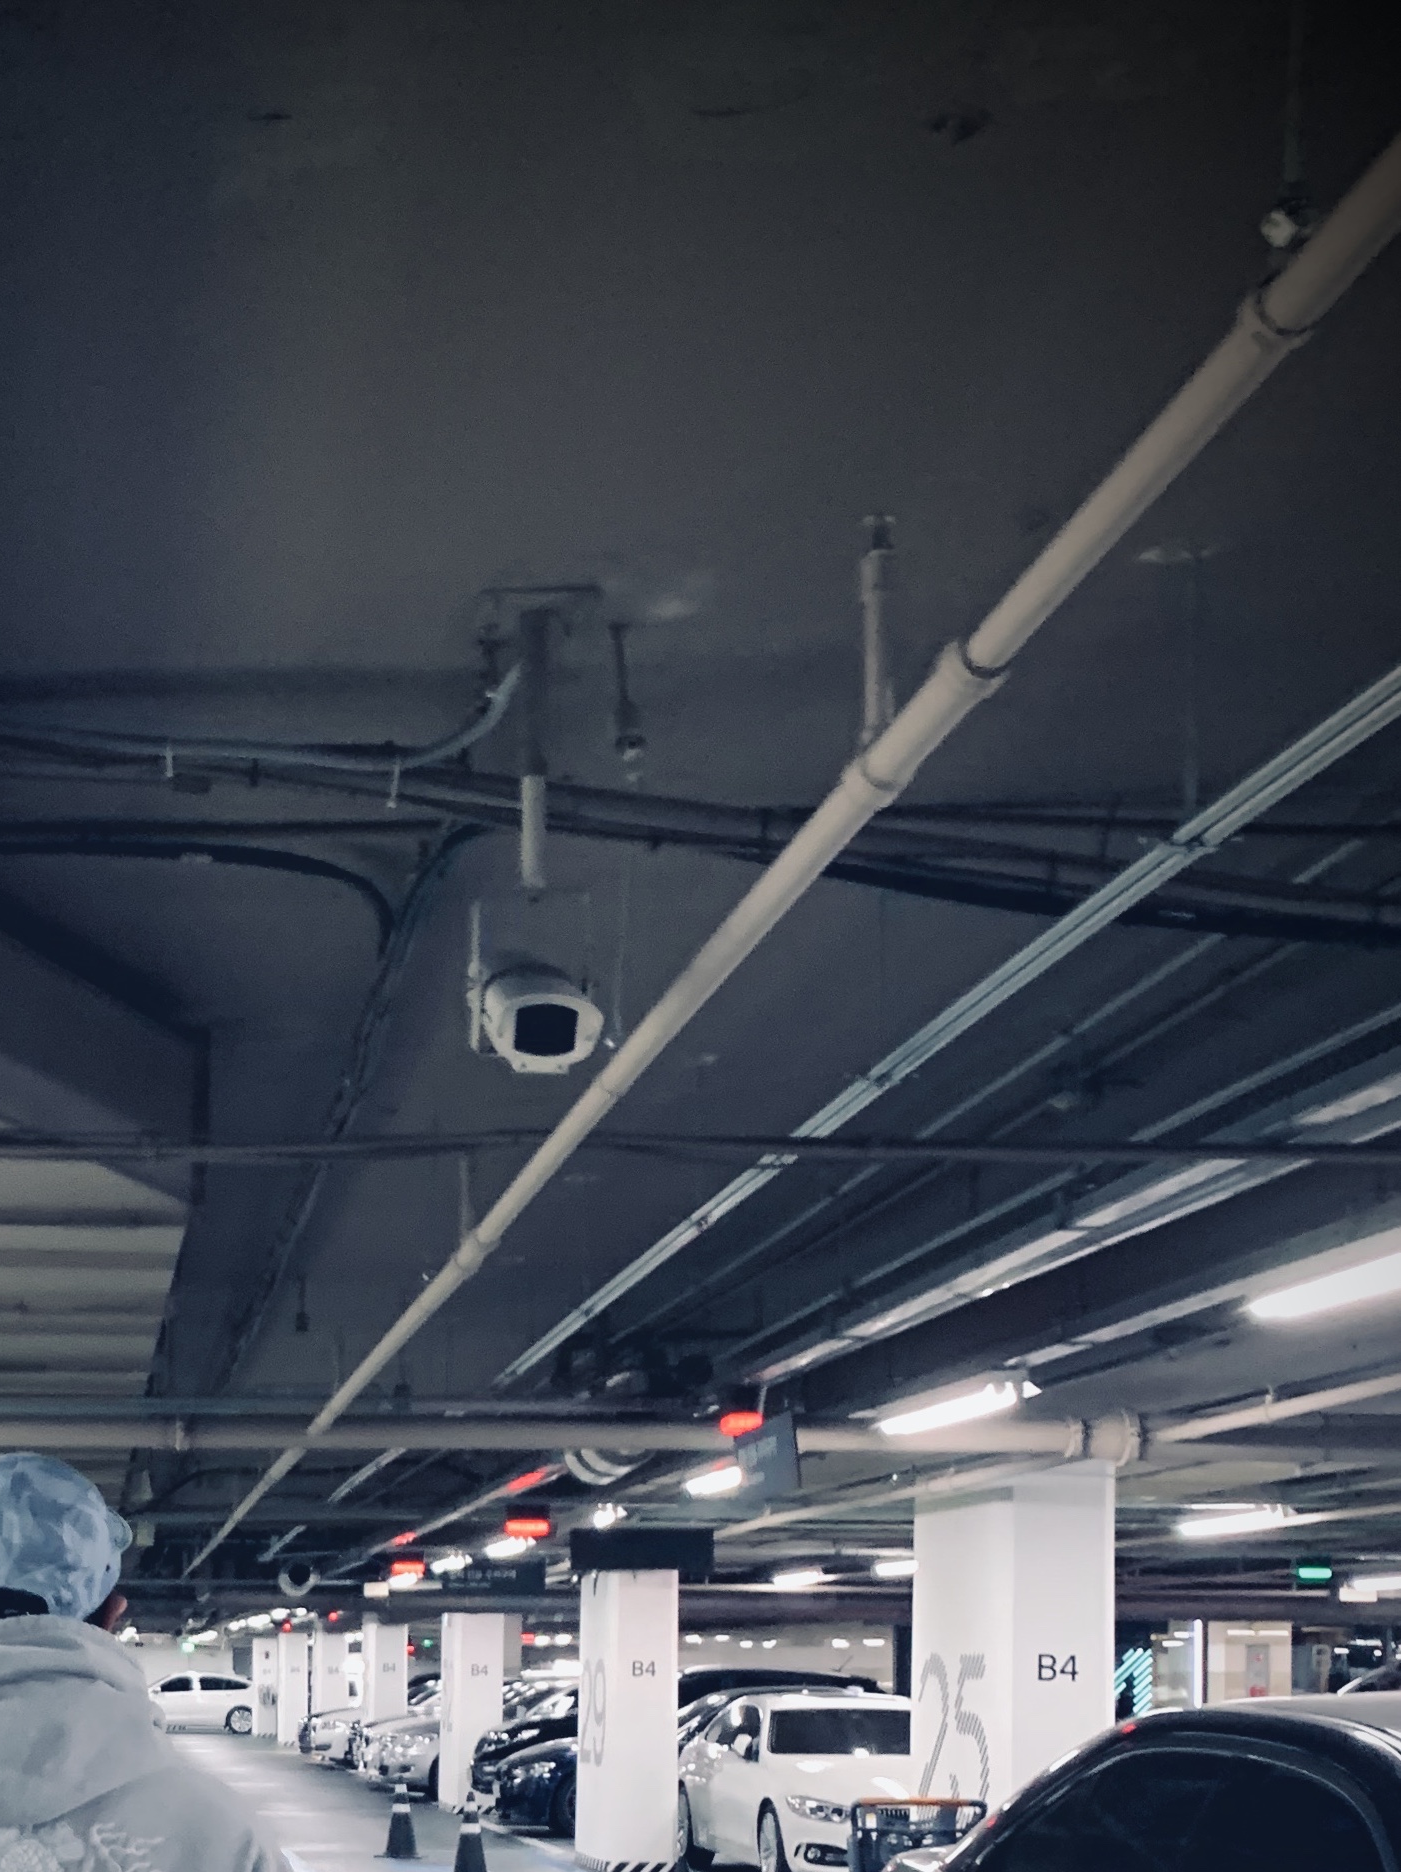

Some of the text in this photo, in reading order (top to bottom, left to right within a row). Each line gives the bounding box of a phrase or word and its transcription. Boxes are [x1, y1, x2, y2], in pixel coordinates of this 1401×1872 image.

[383, 1663, 396, 1673] B4
[471, 1663, 488, 1676] B4
[631, 1660, 656, 1677] B4
[1037, 1654, 1079, 1682] B4
[580, 1658, 606, 1767] 29
